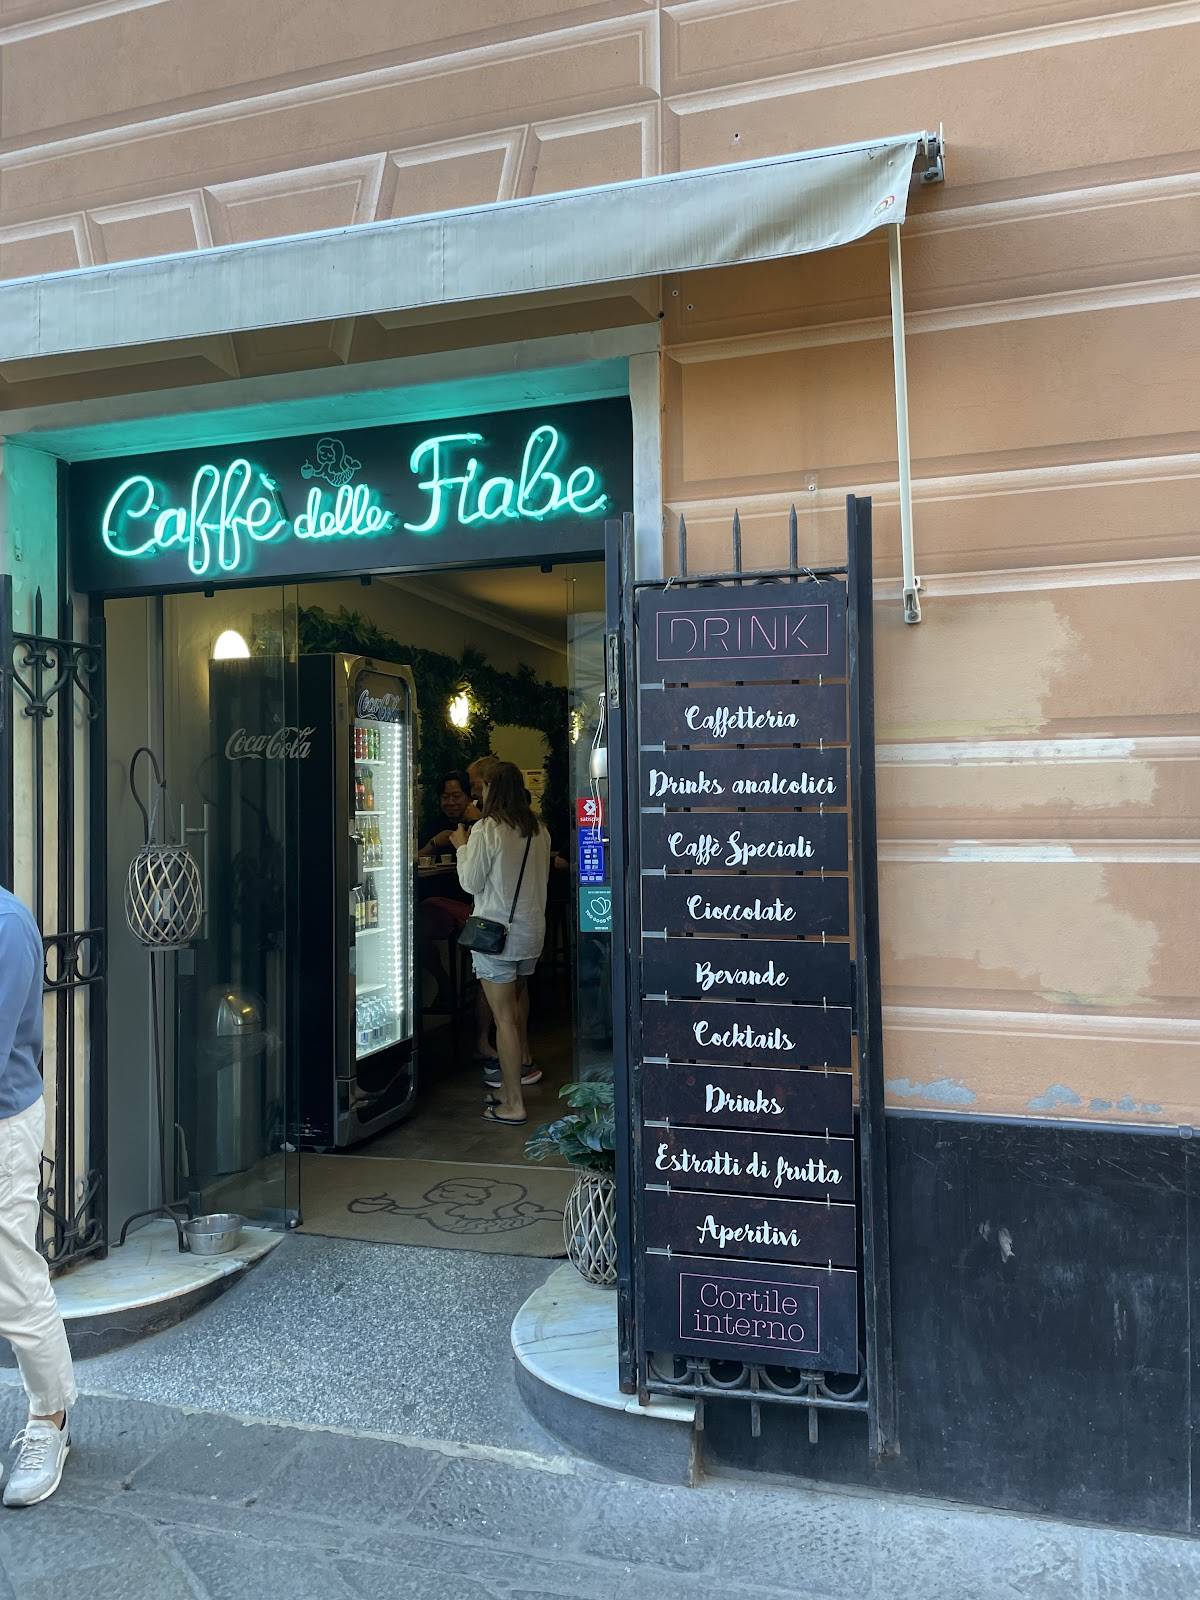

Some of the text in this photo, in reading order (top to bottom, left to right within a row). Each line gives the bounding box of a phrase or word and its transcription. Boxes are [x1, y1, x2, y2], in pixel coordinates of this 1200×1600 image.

[101, 425, 608, 575] Caffè delle Fiabe
[670, 614, 809, 653] DRINK
[684, 705, 800, 738] Caffetteria
[649, 768, 837, 797] Drinks analcolici
[667, 830, 815, 867] Caffè Speciali
[686, 894, 797, 922] Cioccolate
[695, 960, 790, 991] Bevande
[692, 1020, 796, 1051] Cocktails
[705, 1083, 785, 1115] Drinks
[655, 1142, 843, 1189] Estratti di frutta
[696, 1214, 801, 1249] Aperitivi
[700, 1282, 798, 1316] Cortile
[693, 1309, 805, 1343] interno
